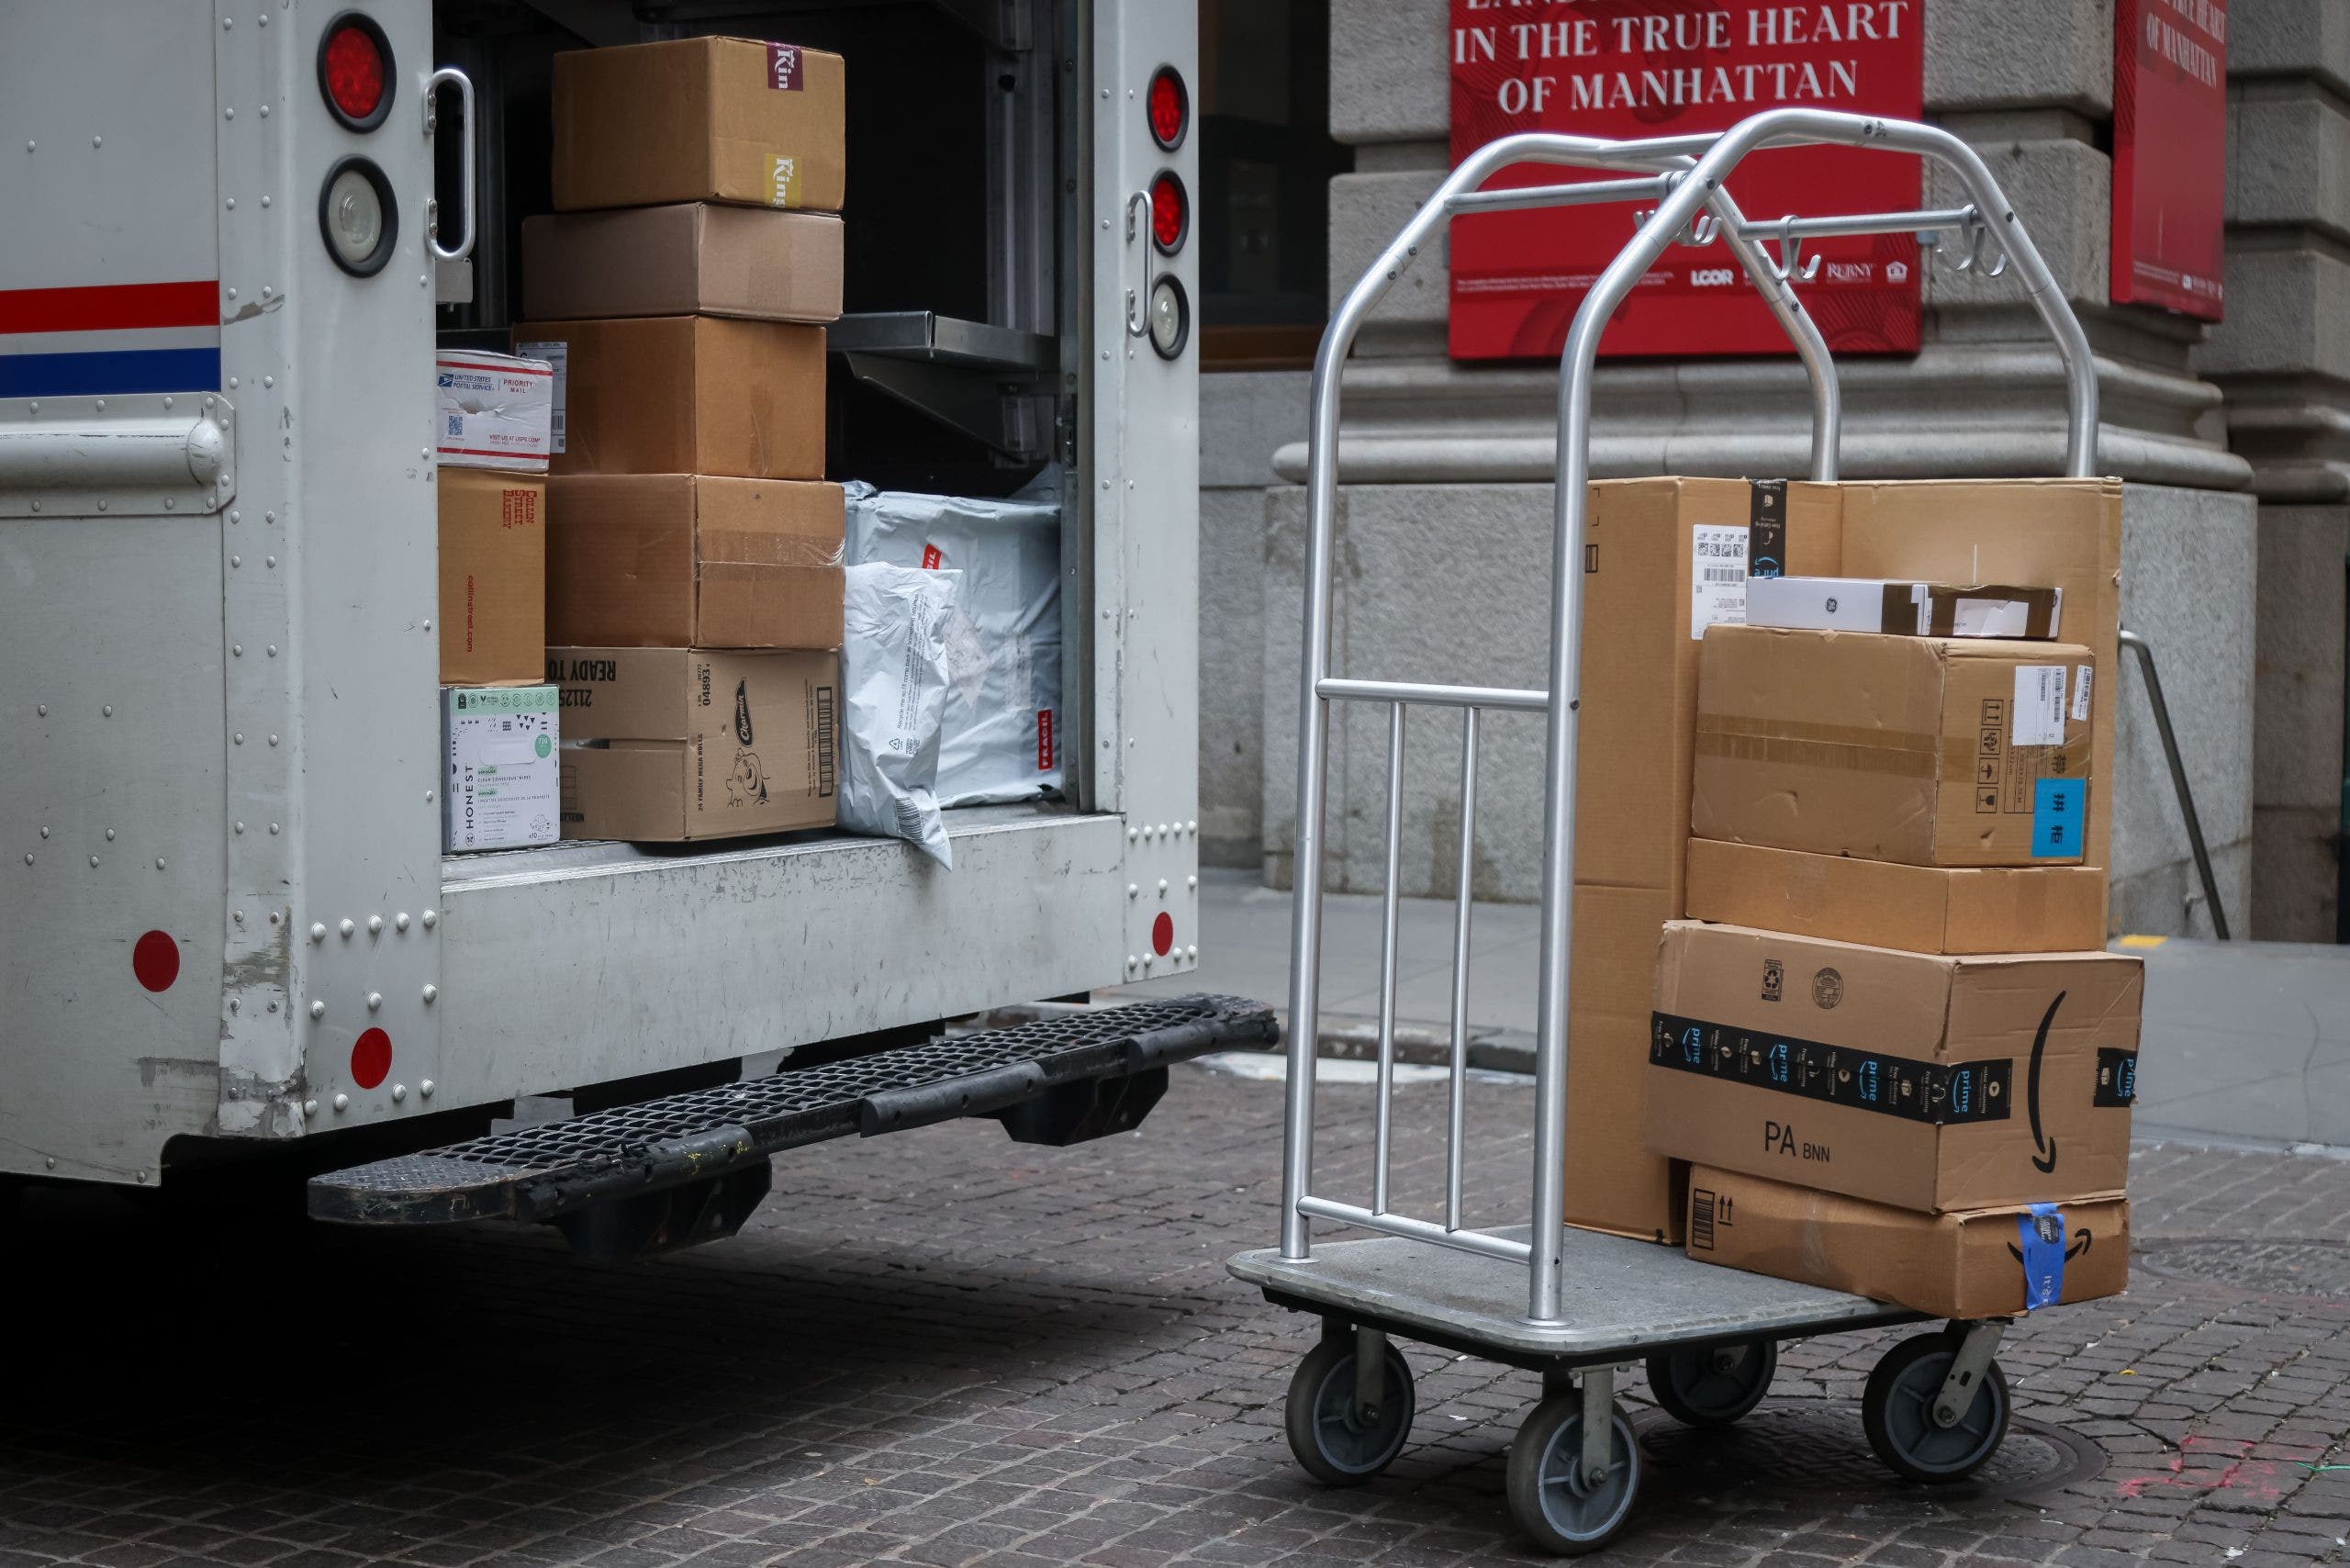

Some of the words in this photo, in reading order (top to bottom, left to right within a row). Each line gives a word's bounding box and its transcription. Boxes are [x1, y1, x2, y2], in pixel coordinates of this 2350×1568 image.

[1454, 27, 1496, 63] IN
[1510, 19, 1598, 60] THE
[1611, 11, 1732, 54] TRUE
[1747, 1, 1908, 46] HEART
[1498, 76, 1557, 115] OF
[1571, 60, 1858, 111] MANHATTAN
[1690, 268, 1734, 286] LCOR
[503, 378, 534, 387] PRIORITY
[502, 488, 515, 530] BAKERY
[514, 489, 526, 525] STREET
[526, 489, 538, 524] COLLIN
[465, 575, 475, 653] collinstreet.com
[547, 660, 566, 681] TO
[570, 660, 617, 681] READY
[702, 668, 711, 706] 04893
[738, 694, 751, 741] Charmin
[464, 766, 474, 829] HONEST
[698, 802, 703, 812] 24
[1778, 1043, 1789, 1083] prme
[1961, 1070, 1972, 1114] prime
[1764, 1120, 1796, 1157] PA
[1802, 1142, 1830, 1163] BNN
